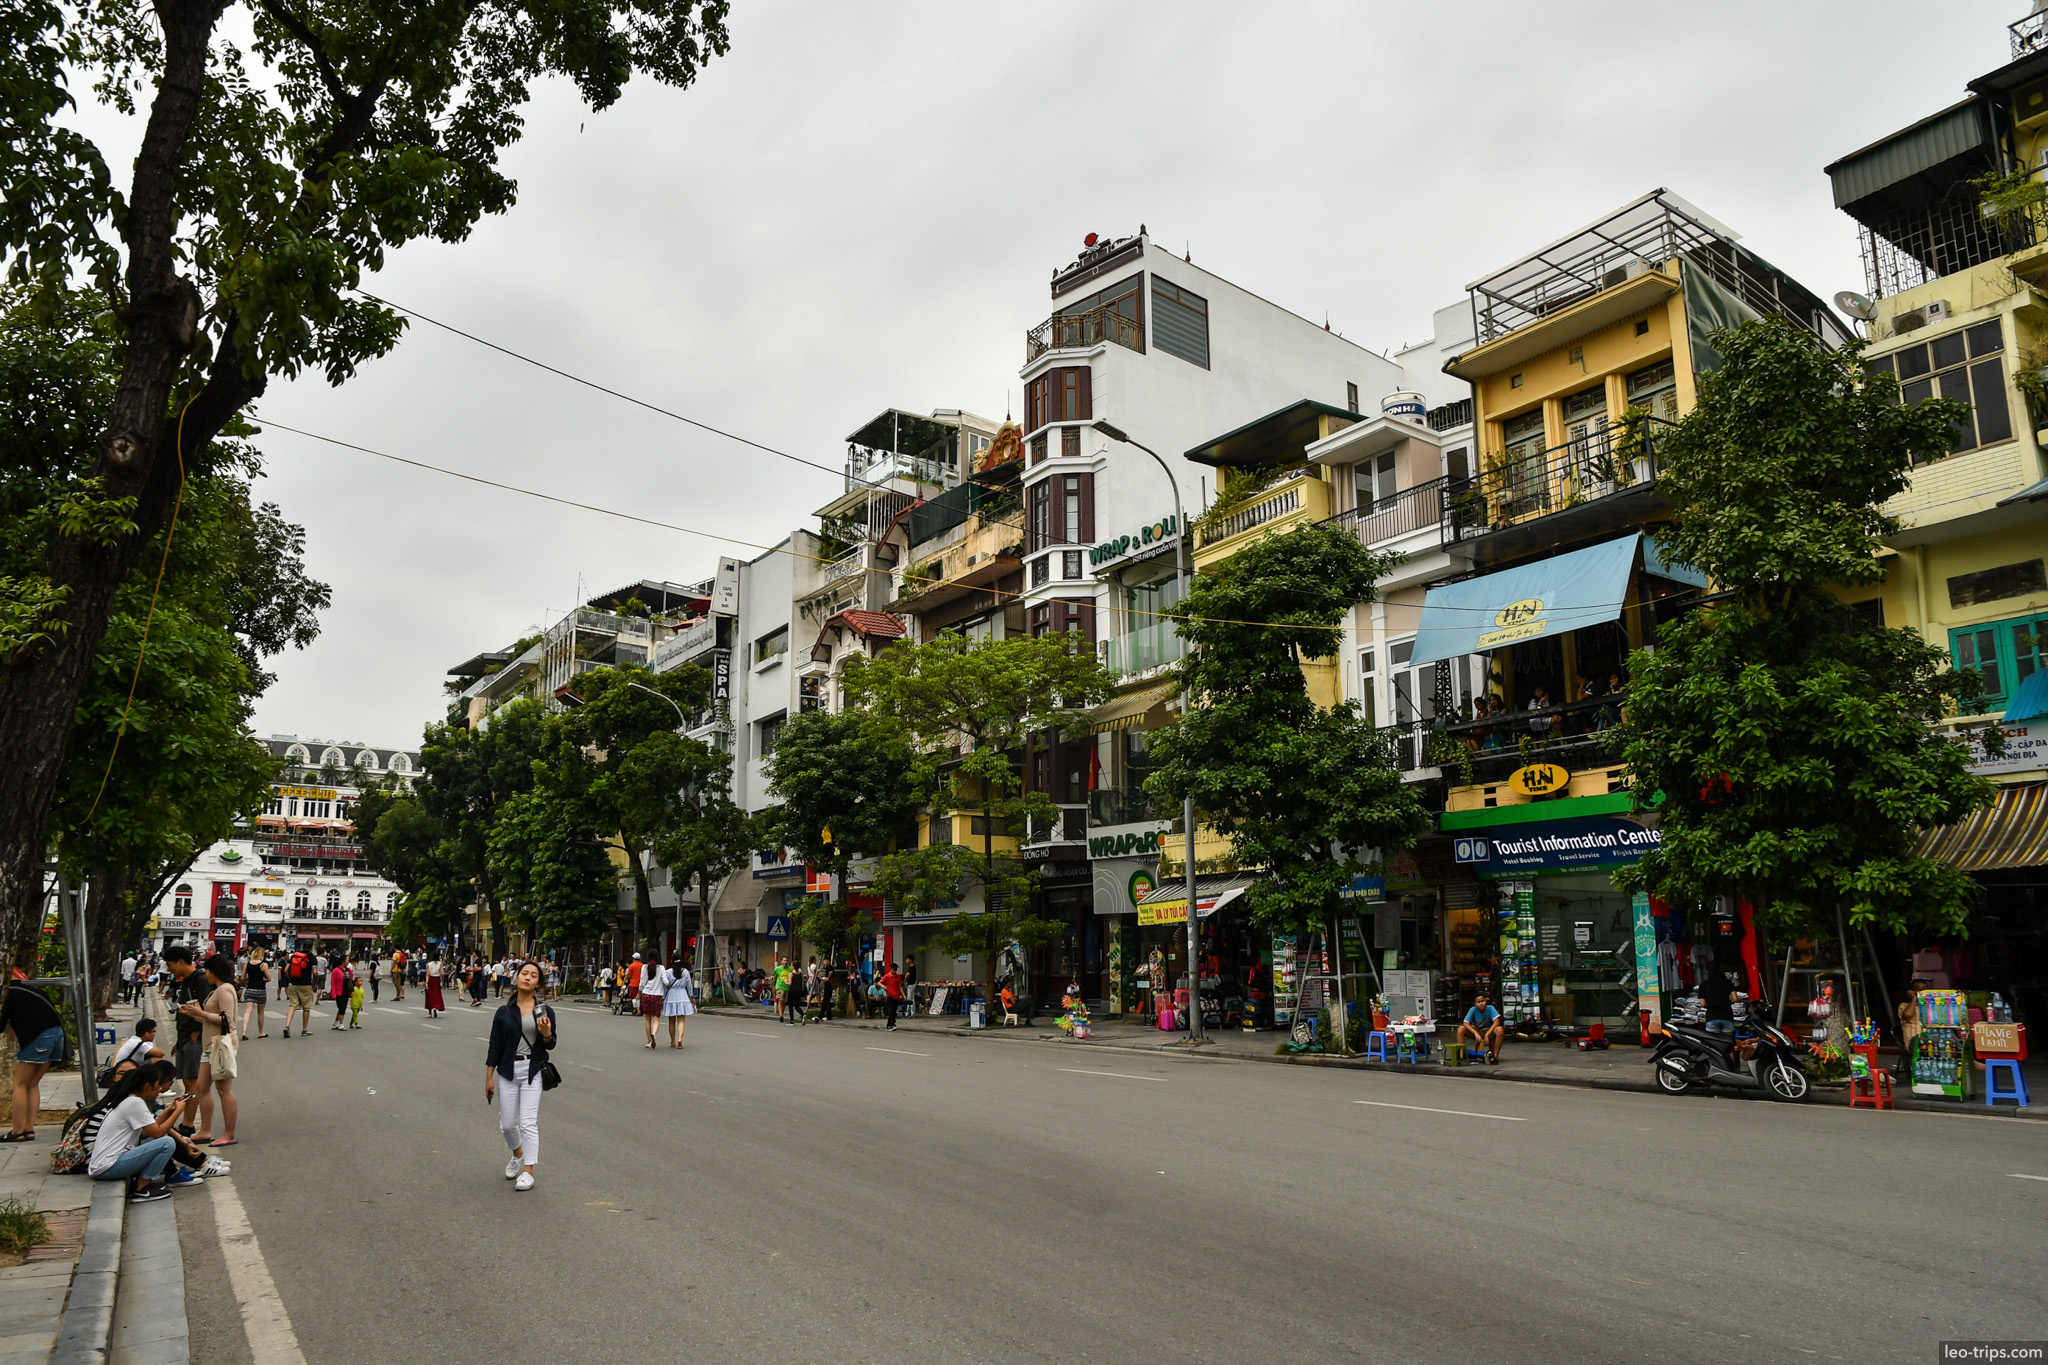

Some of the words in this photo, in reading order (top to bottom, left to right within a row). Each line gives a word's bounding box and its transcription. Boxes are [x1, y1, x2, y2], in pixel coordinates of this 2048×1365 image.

[1089, 535, 1130, 566] WRAP
[1132, 536, 1140, 549] &
[1142, 515, 1177, 545] ROLL
[716, 664, 728, 698] SPA
[309, 789, 337, 800] CLUB
[1492, 837, 1540, 855] Tourist
[1539, 831, 1618, 852] Information
[1558, 853, 1578, 861] Travel
[165, 920, 187, 928] HSBC
